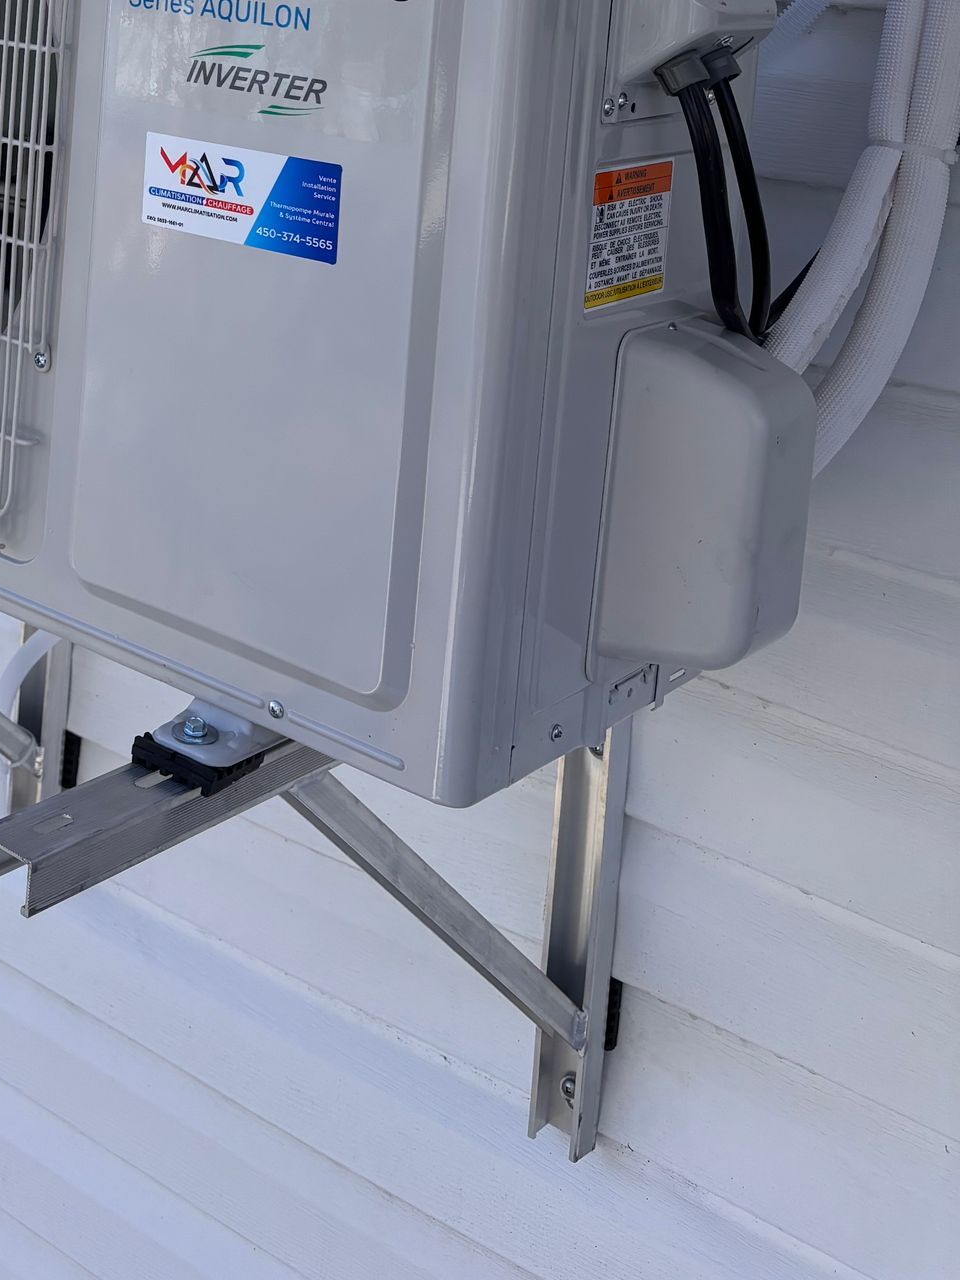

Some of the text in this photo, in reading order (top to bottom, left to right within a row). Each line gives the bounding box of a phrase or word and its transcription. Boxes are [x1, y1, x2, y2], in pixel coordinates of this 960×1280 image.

[186, 60, 328, 105] INVERTER
[160, 146, 244, 198] MAR
[319, 175, 336, 184] Vente
[624, 169, 647, 180] WARNING
[302, 181, 336, 192] Installation
[617, 183, 655, 198] AVERTISSEMENT
[150, 187, 252, 215] CLIMATISATION CHAUFFAGE
[313, 192, 336, 201] Service
[628, 198, 647, 207] ELECTRIC
[270, 201, 335, 219] Thermopompe Murale
[606, 212, 615, 220] CAN
[285, 212, 311, 223] Système
[313, 218, 335, 227] Central
[256, 227, 333, 250] 450-374-5565
